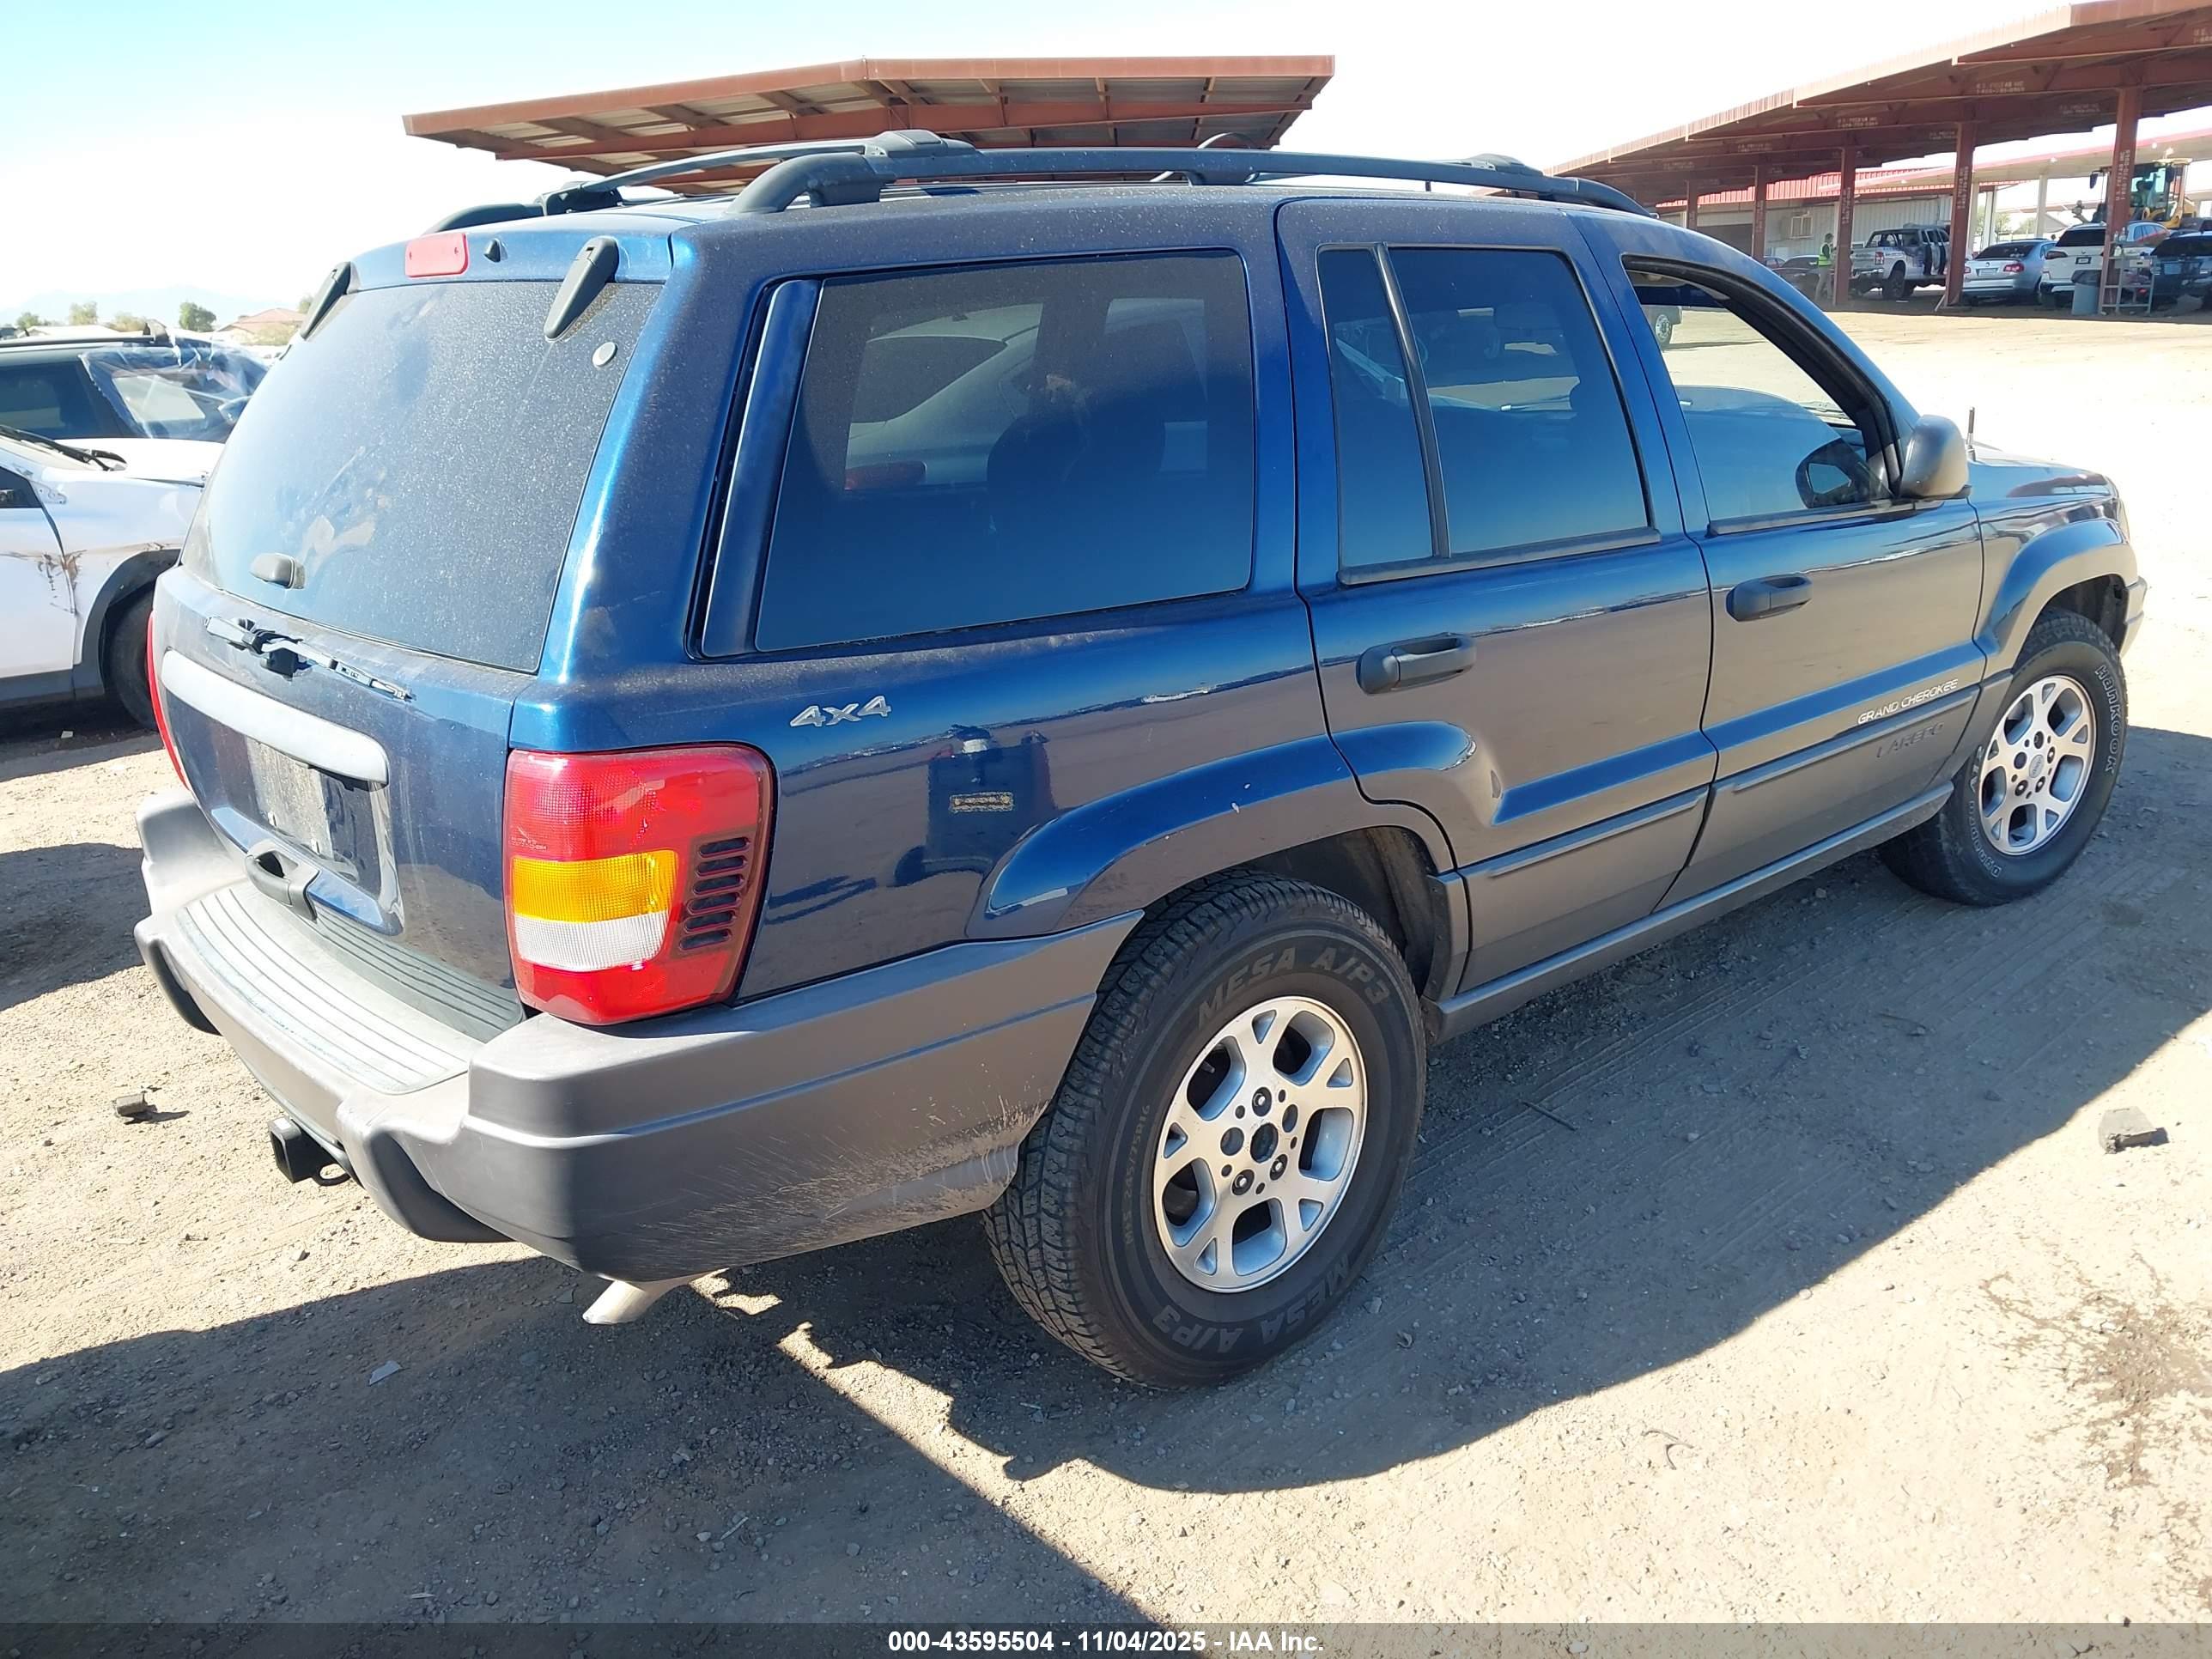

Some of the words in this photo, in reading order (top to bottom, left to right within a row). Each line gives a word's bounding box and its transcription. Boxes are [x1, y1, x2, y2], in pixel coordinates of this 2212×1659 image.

[1857, 702, 1900, 725] GRAND
[1901, 678, 1959, 708] CHEROKEE
[1197, 946, 1297, 1030] MESA
[1311, 946, 1391, 1005] A/P3
[1260, 1254, 1352, 1345] MESA
